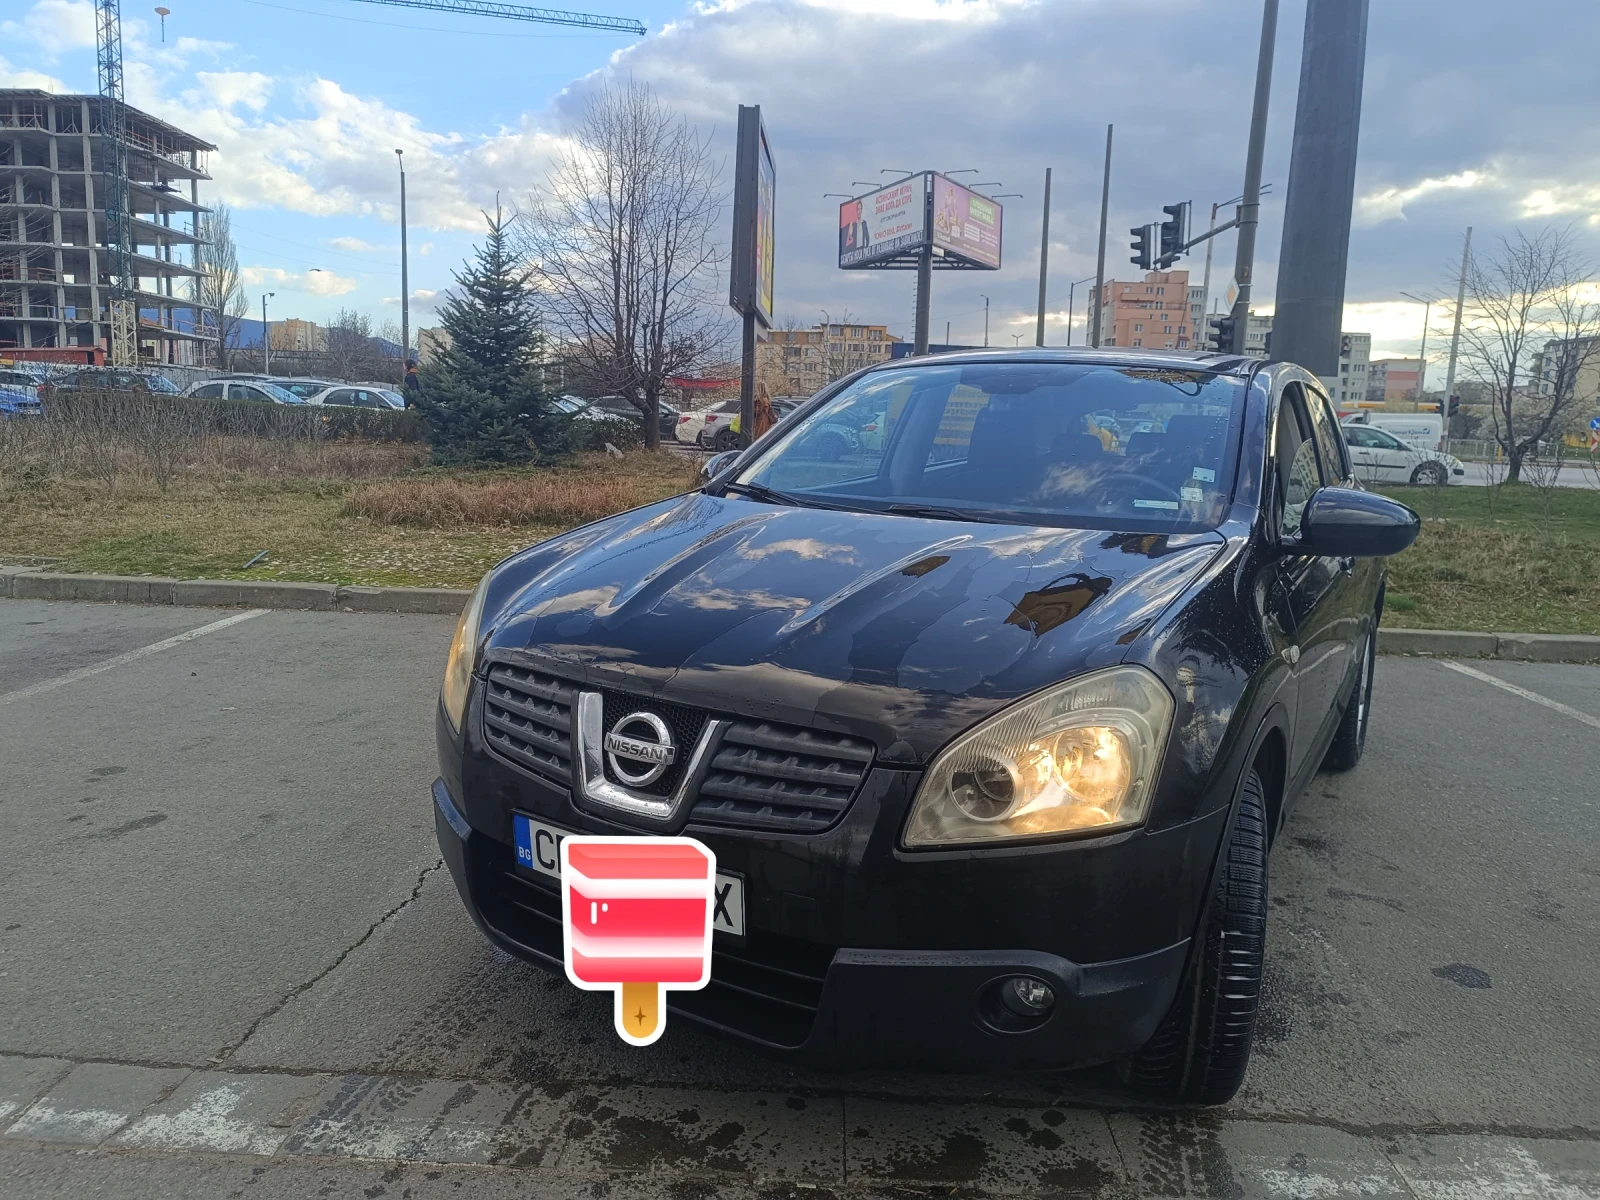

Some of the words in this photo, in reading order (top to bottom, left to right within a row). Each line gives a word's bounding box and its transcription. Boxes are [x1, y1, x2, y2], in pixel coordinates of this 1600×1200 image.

[607, 735, 664, 760] NISSAN
[518, 845, 531, 861] BG
[535, 829, 561, 874] C
